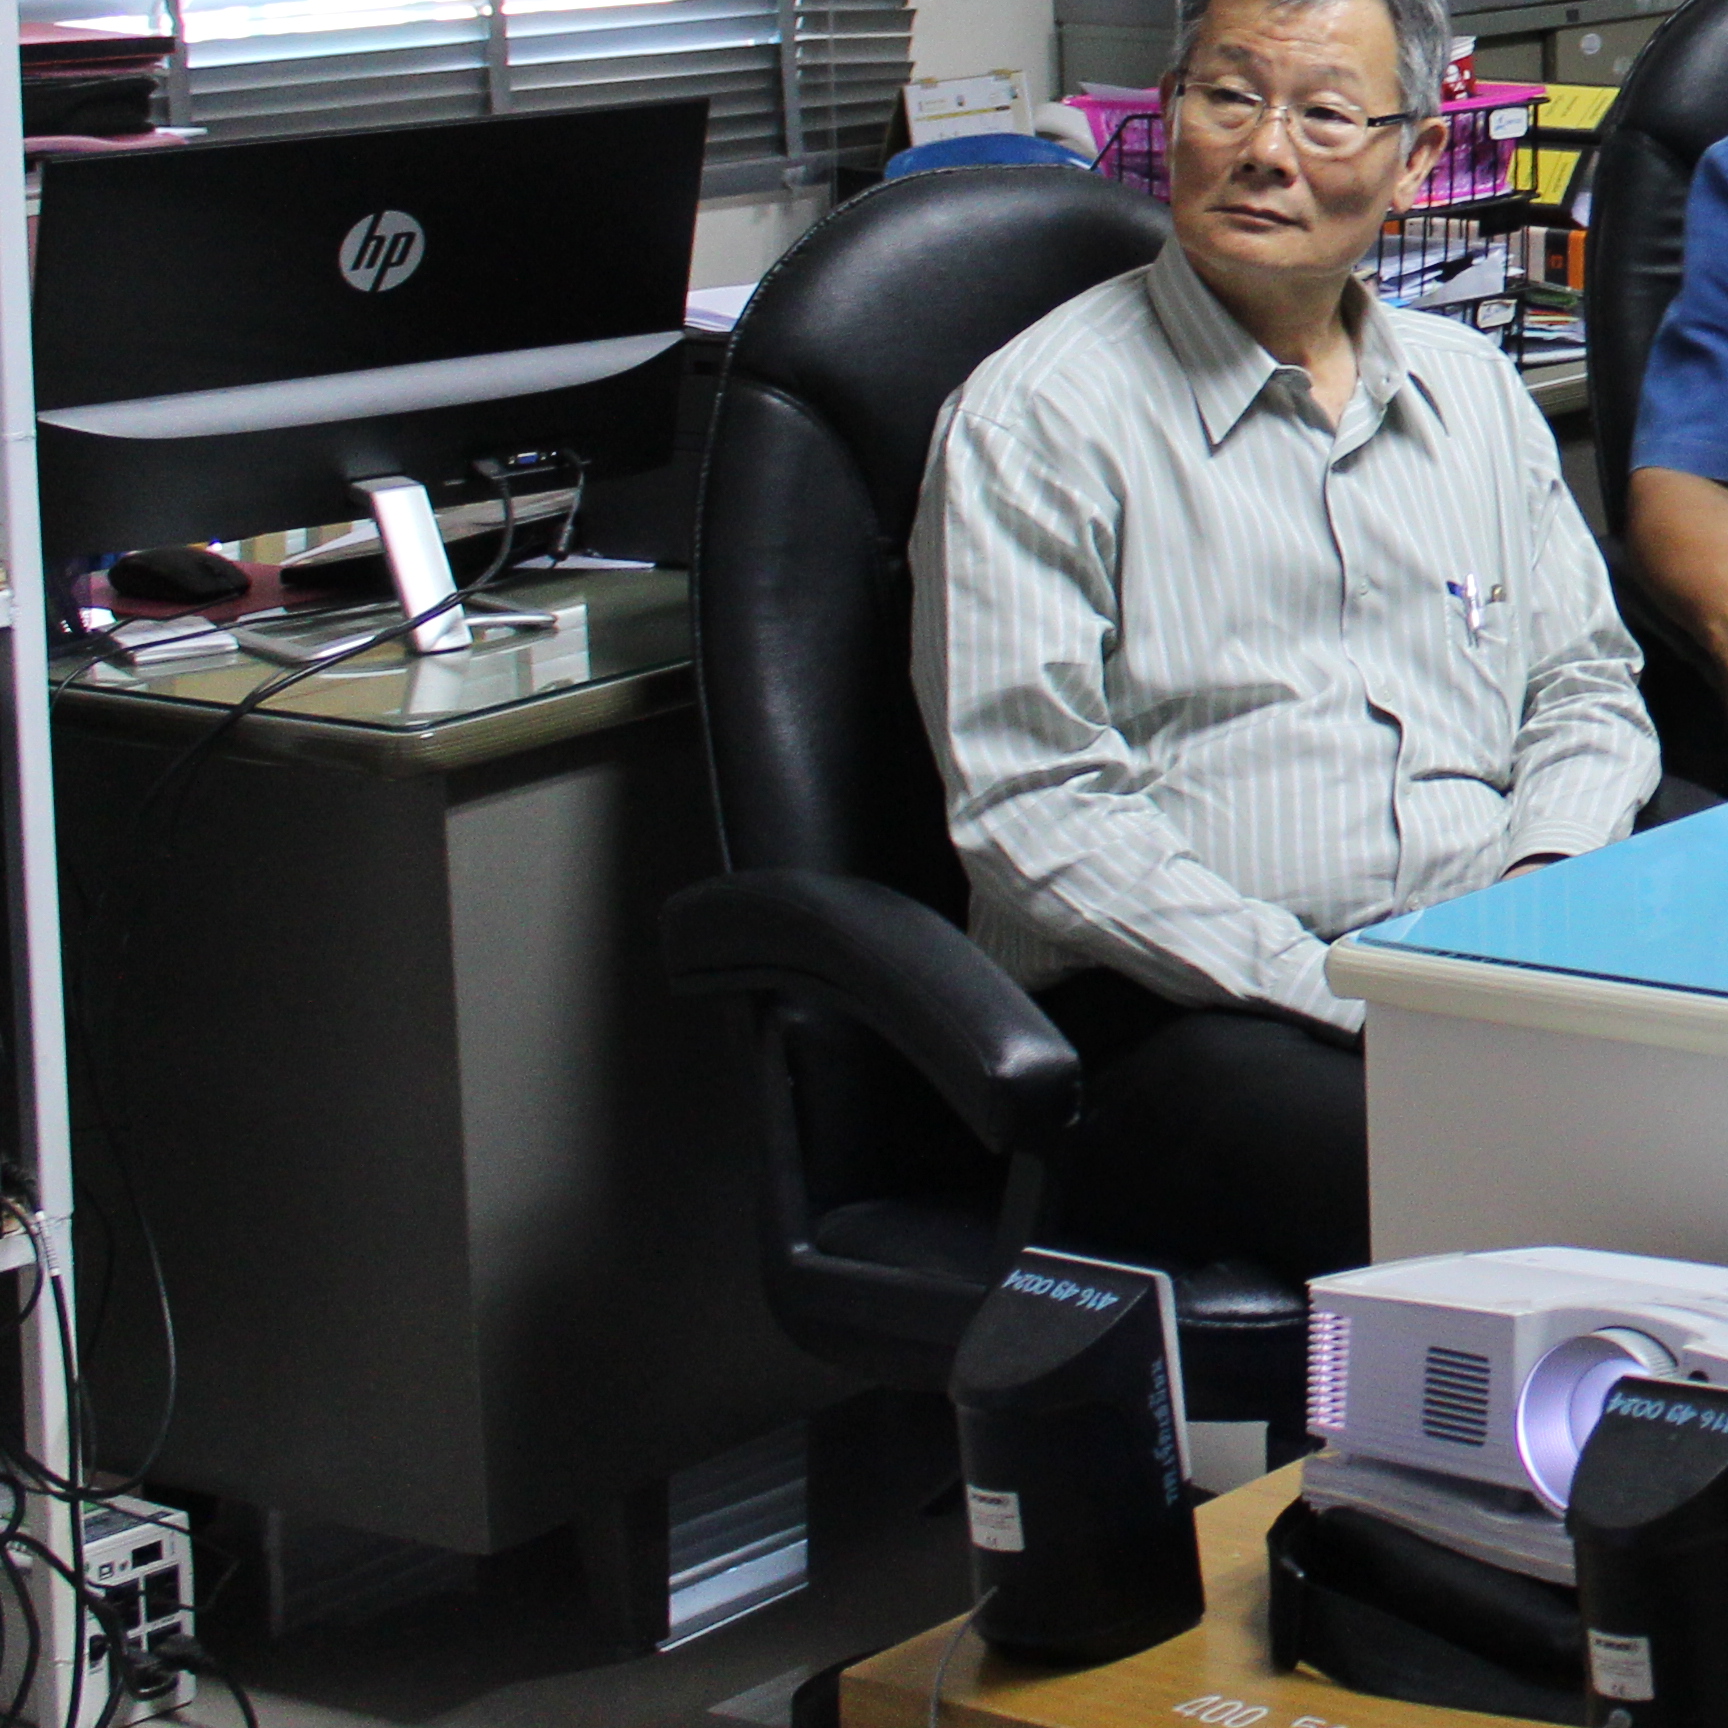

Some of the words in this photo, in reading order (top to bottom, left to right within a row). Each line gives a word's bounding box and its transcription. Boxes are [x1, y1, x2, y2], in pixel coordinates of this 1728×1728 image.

[346, 210, 418, 292] hp
[1001, 1268, 1056, 1296] 0024
[1050, 1279, 1080, 1303] 49
[1075, 1290, 1121, 1312] 416
[1605, 1392, 1666, 1419] 0024
[1171, 1694, 1269, 1728] 400
